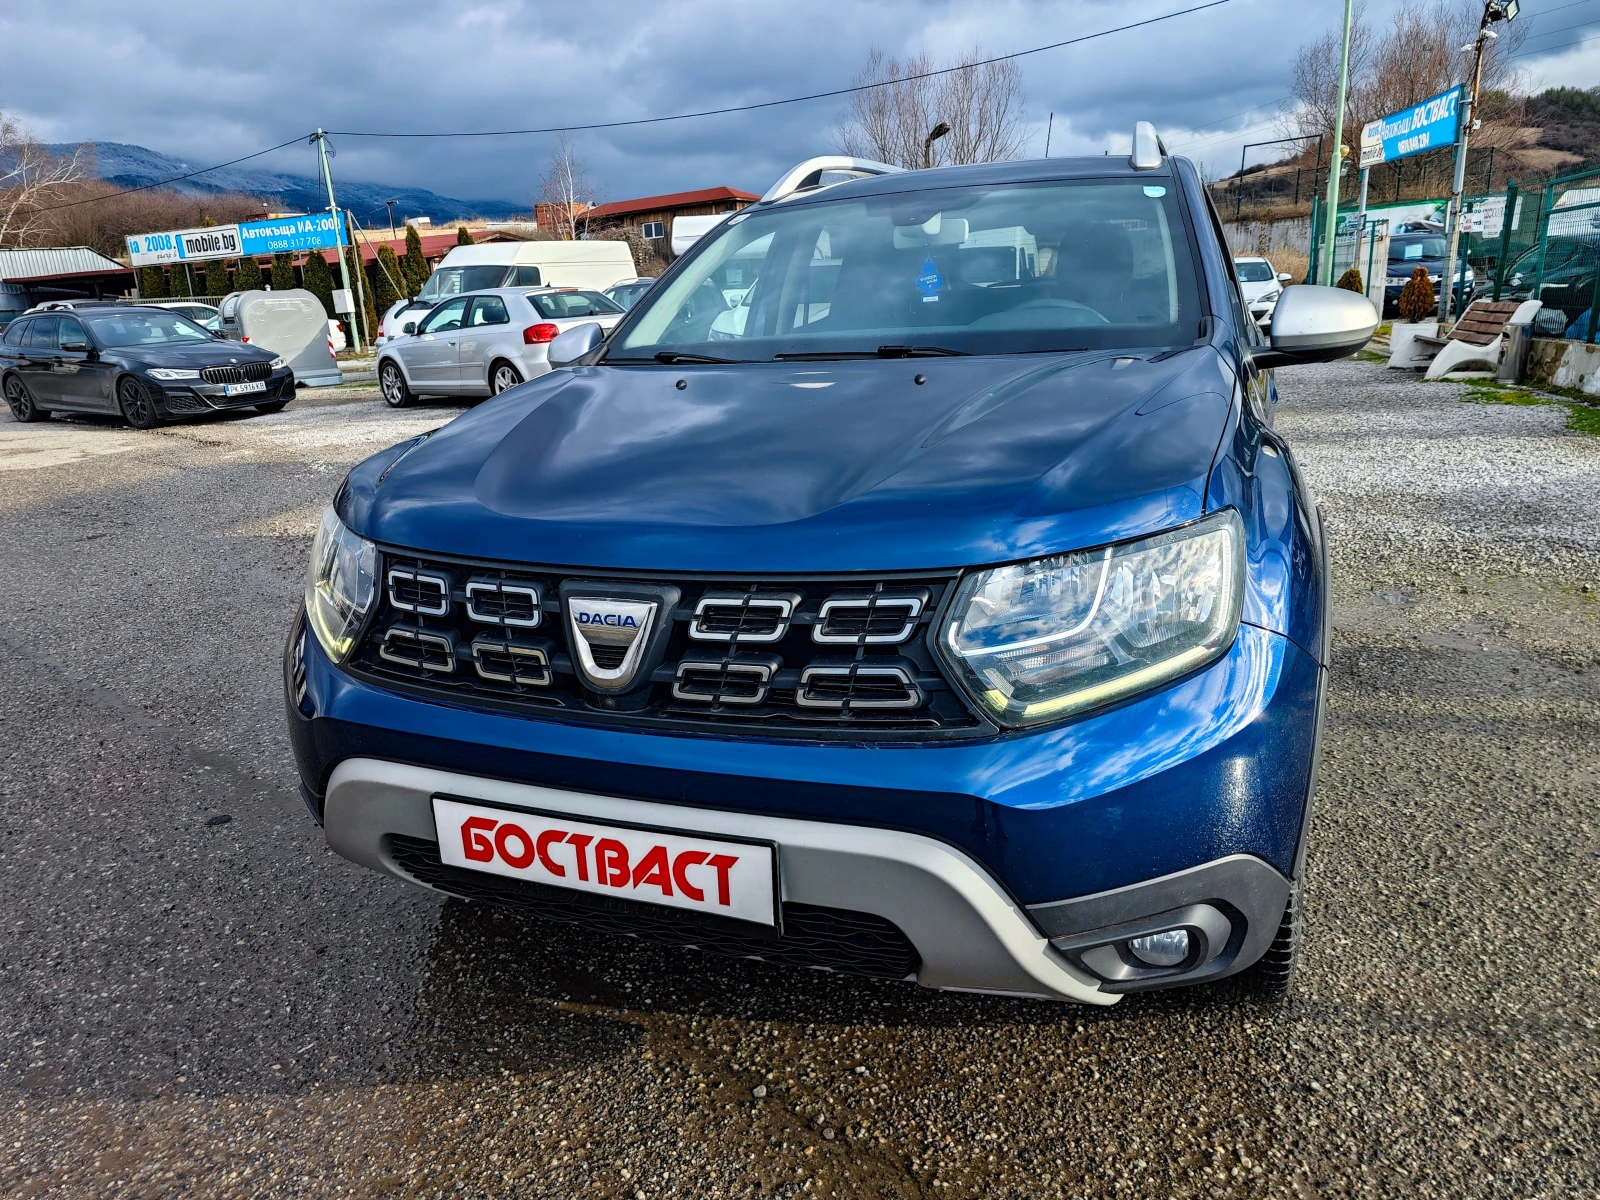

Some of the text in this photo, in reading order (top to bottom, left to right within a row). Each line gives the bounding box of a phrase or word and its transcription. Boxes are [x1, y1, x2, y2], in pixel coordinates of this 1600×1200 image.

[1411, 90, 1459, 130] БОСТВАСТ
[242, 224, 296, 240] Автокъща
[186, 233, 236, 254] mobile.bg
[267, 240, 288, 250] 0888
[290, 238, 304, 248] 317
[240, 384, 256, 392] 5916
[578, 612, 637, 628] DACIA
[460, 815, 740, 907] БОСТВАСТ
